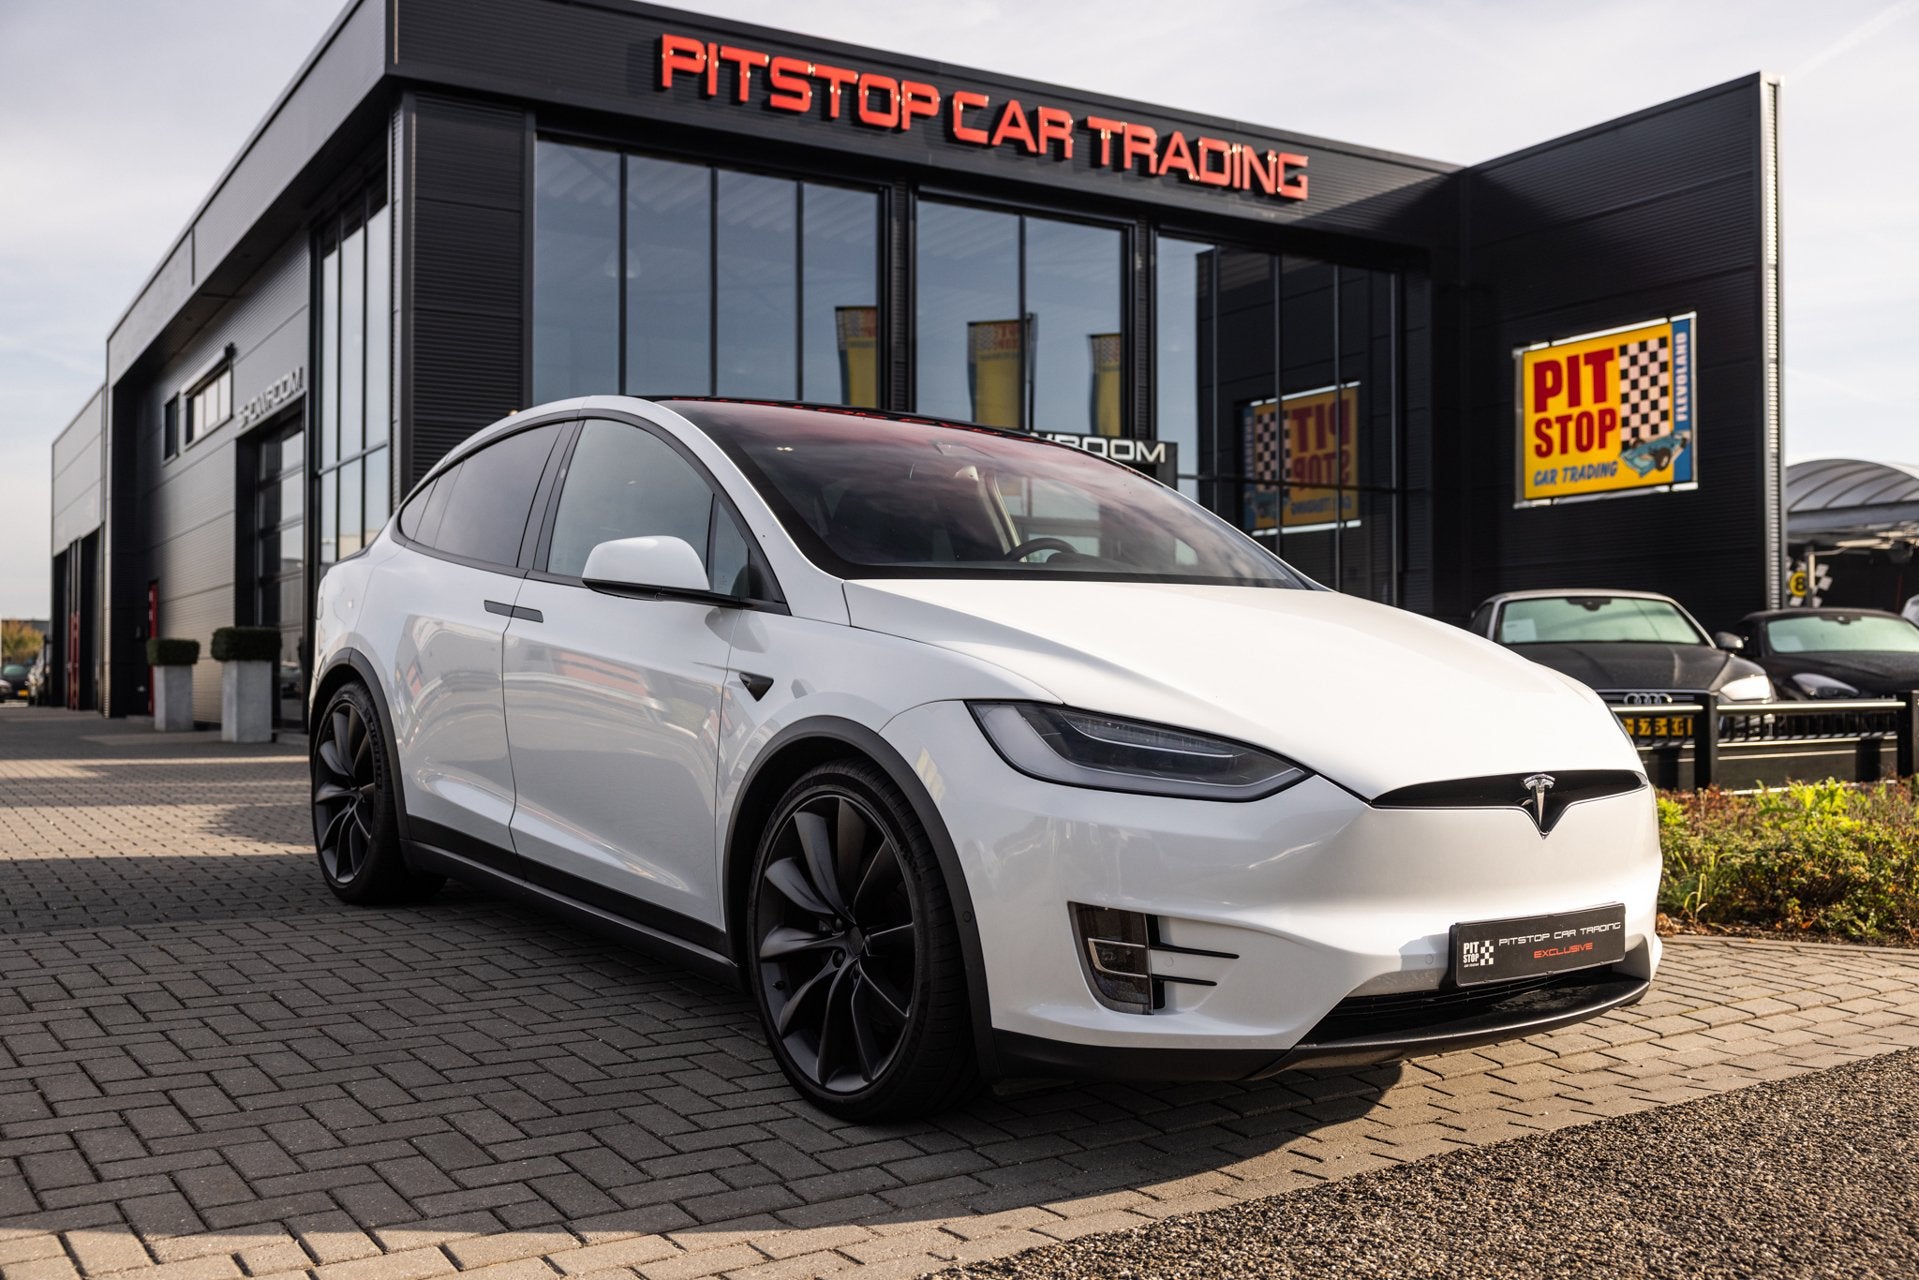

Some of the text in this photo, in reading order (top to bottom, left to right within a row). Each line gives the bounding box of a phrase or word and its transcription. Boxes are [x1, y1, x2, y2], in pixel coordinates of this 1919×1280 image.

[661, 33, 1309, 200] PITSTOP CAR TRADING
[1533, 348, 1615, 414] PIT
[1534, 408, 1617, 459] STOP
[1533, 461, 1618, 487] CAR TRADING
[1498, 921, 1622, 947] PITSTOP CAR TRADING
[1463, 941, 1480, 955] PIT
[1463, 953, 1480, 964] STOP
[1534, 942, 1593, 959] EXCLUSIVE
